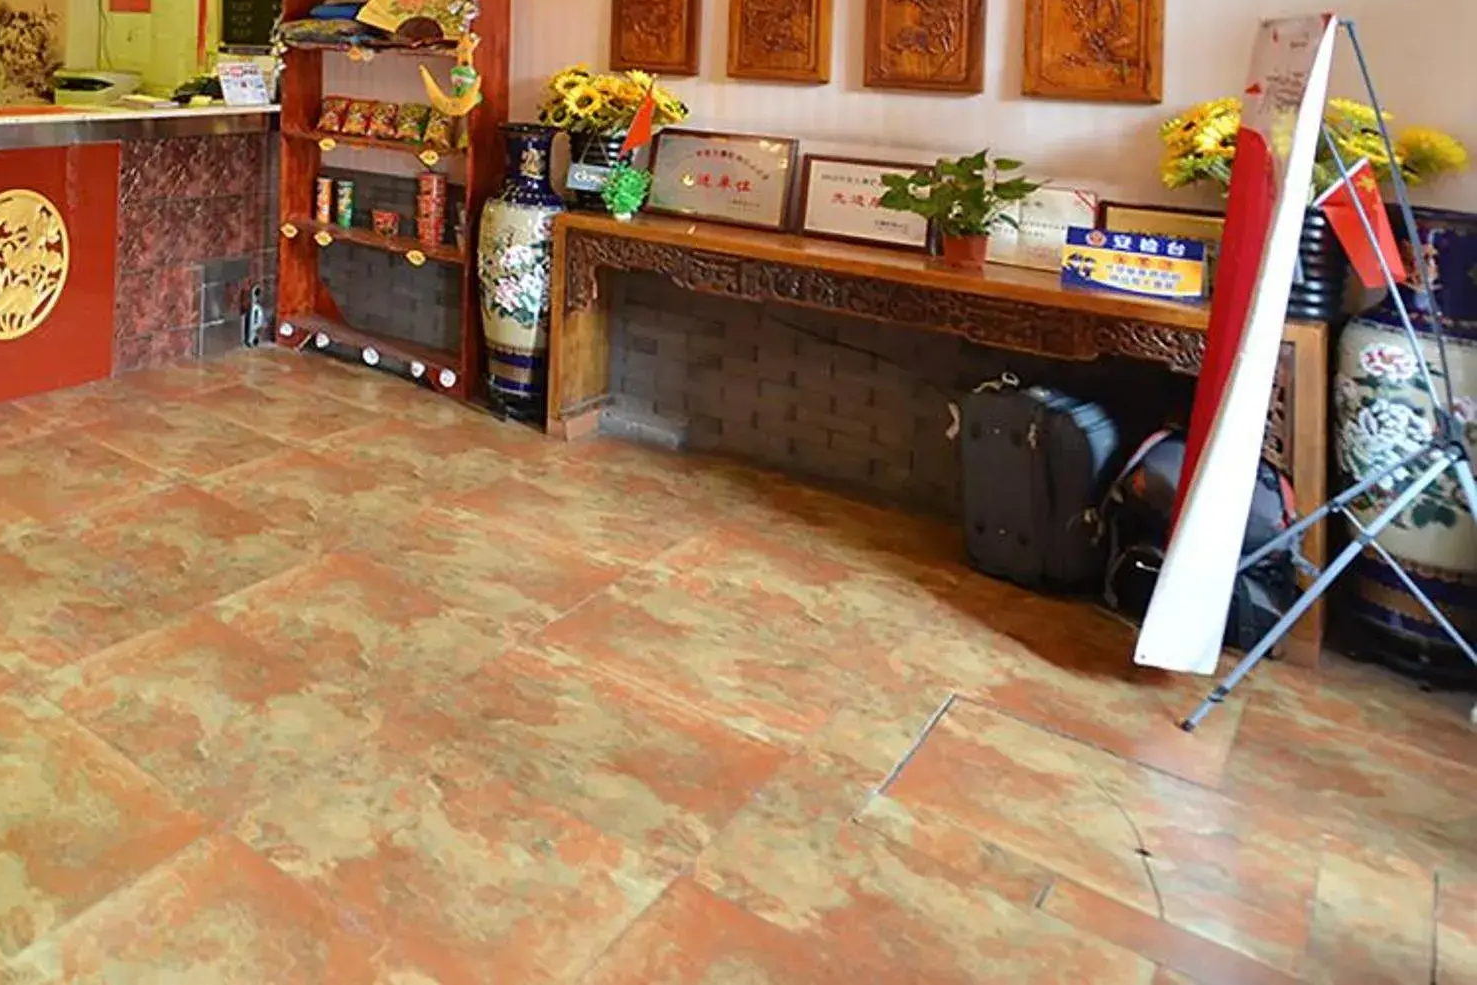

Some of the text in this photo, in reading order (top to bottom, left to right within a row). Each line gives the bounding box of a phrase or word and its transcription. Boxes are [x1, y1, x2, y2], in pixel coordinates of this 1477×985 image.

[681, 173, 753, 194] 进单位
[1113, 234, 1186, 257] 安检台
